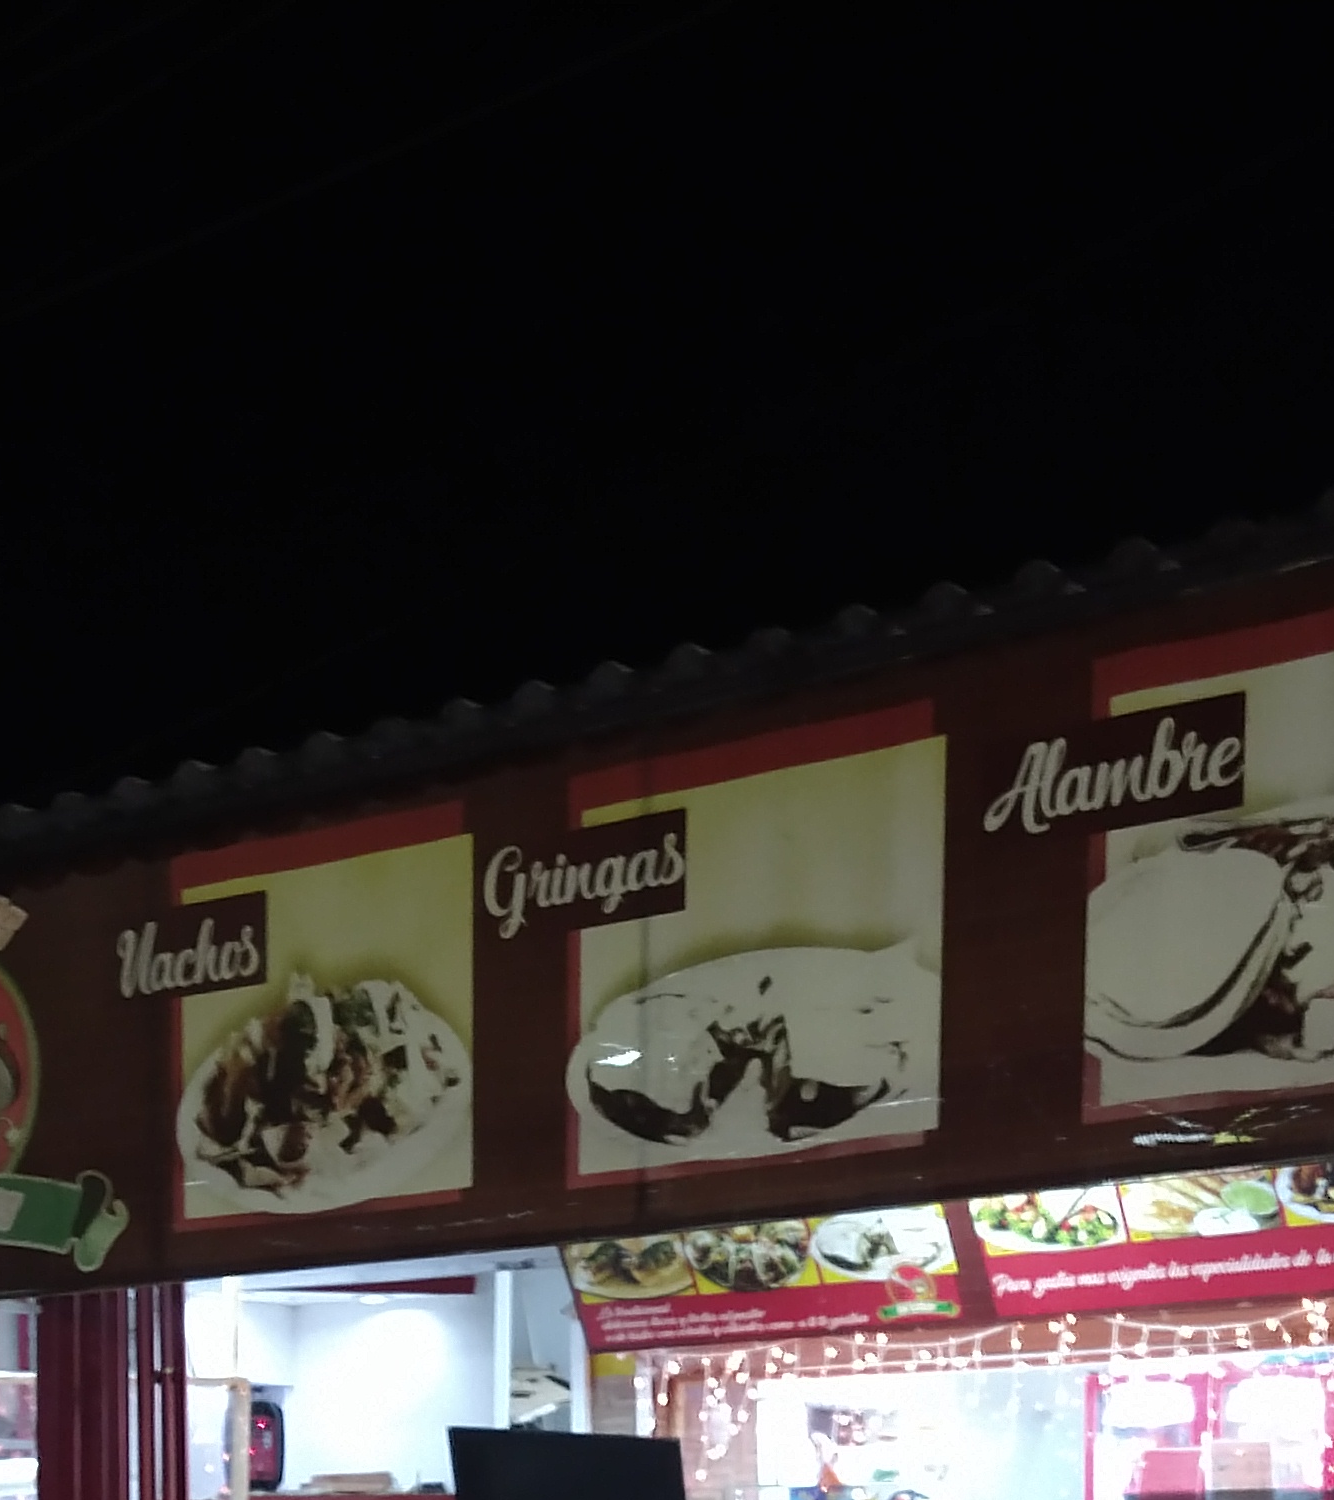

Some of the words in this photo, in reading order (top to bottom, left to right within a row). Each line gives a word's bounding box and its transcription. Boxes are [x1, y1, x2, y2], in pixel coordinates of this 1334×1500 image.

[983, 717, 1244, 835] Alambre
[483, 831, 686, 939] Gringas
[116, 918, 261, 999] Nachos
